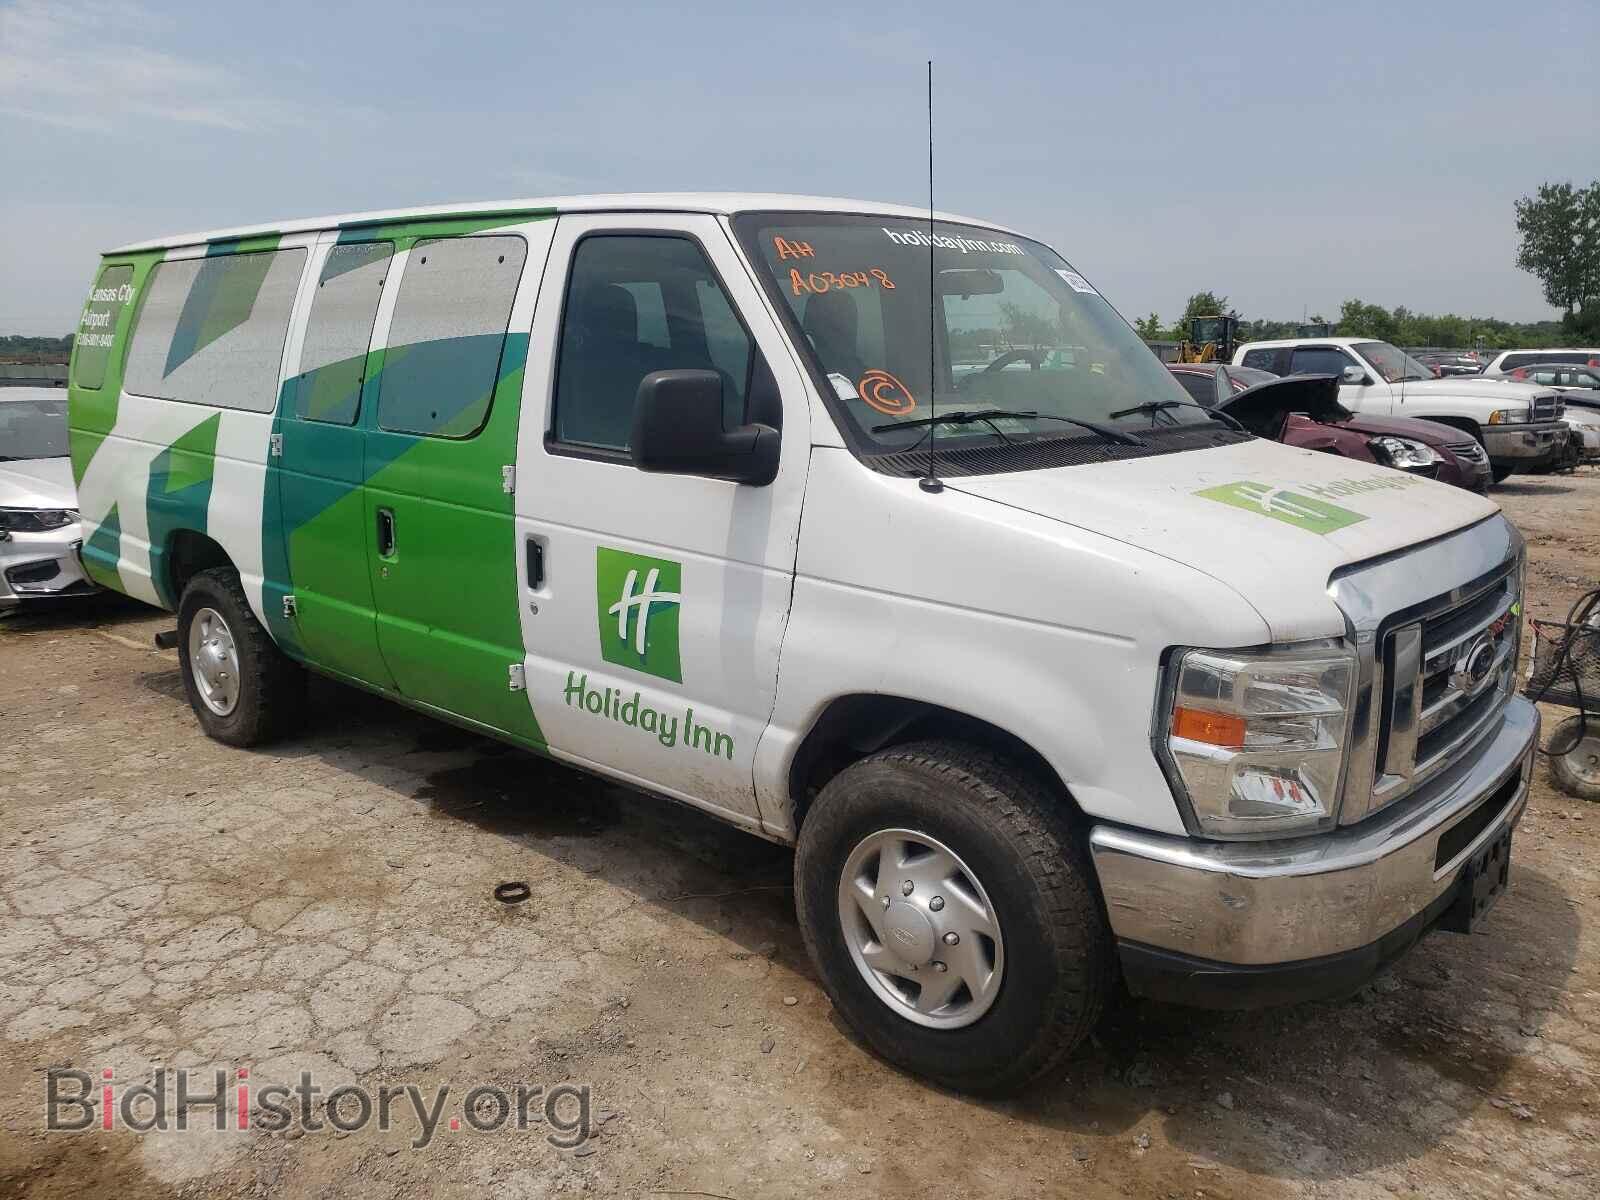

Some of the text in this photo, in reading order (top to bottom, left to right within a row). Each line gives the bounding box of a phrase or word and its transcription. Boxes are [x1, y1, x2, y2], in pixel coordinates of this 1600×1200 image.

[881, 227, 1025, 255] holidayinn.com
[118, 283, 136, 306] City
[80, 309, 111, 330] Airport
[563, 670, 735, 761] Holiday Inn
